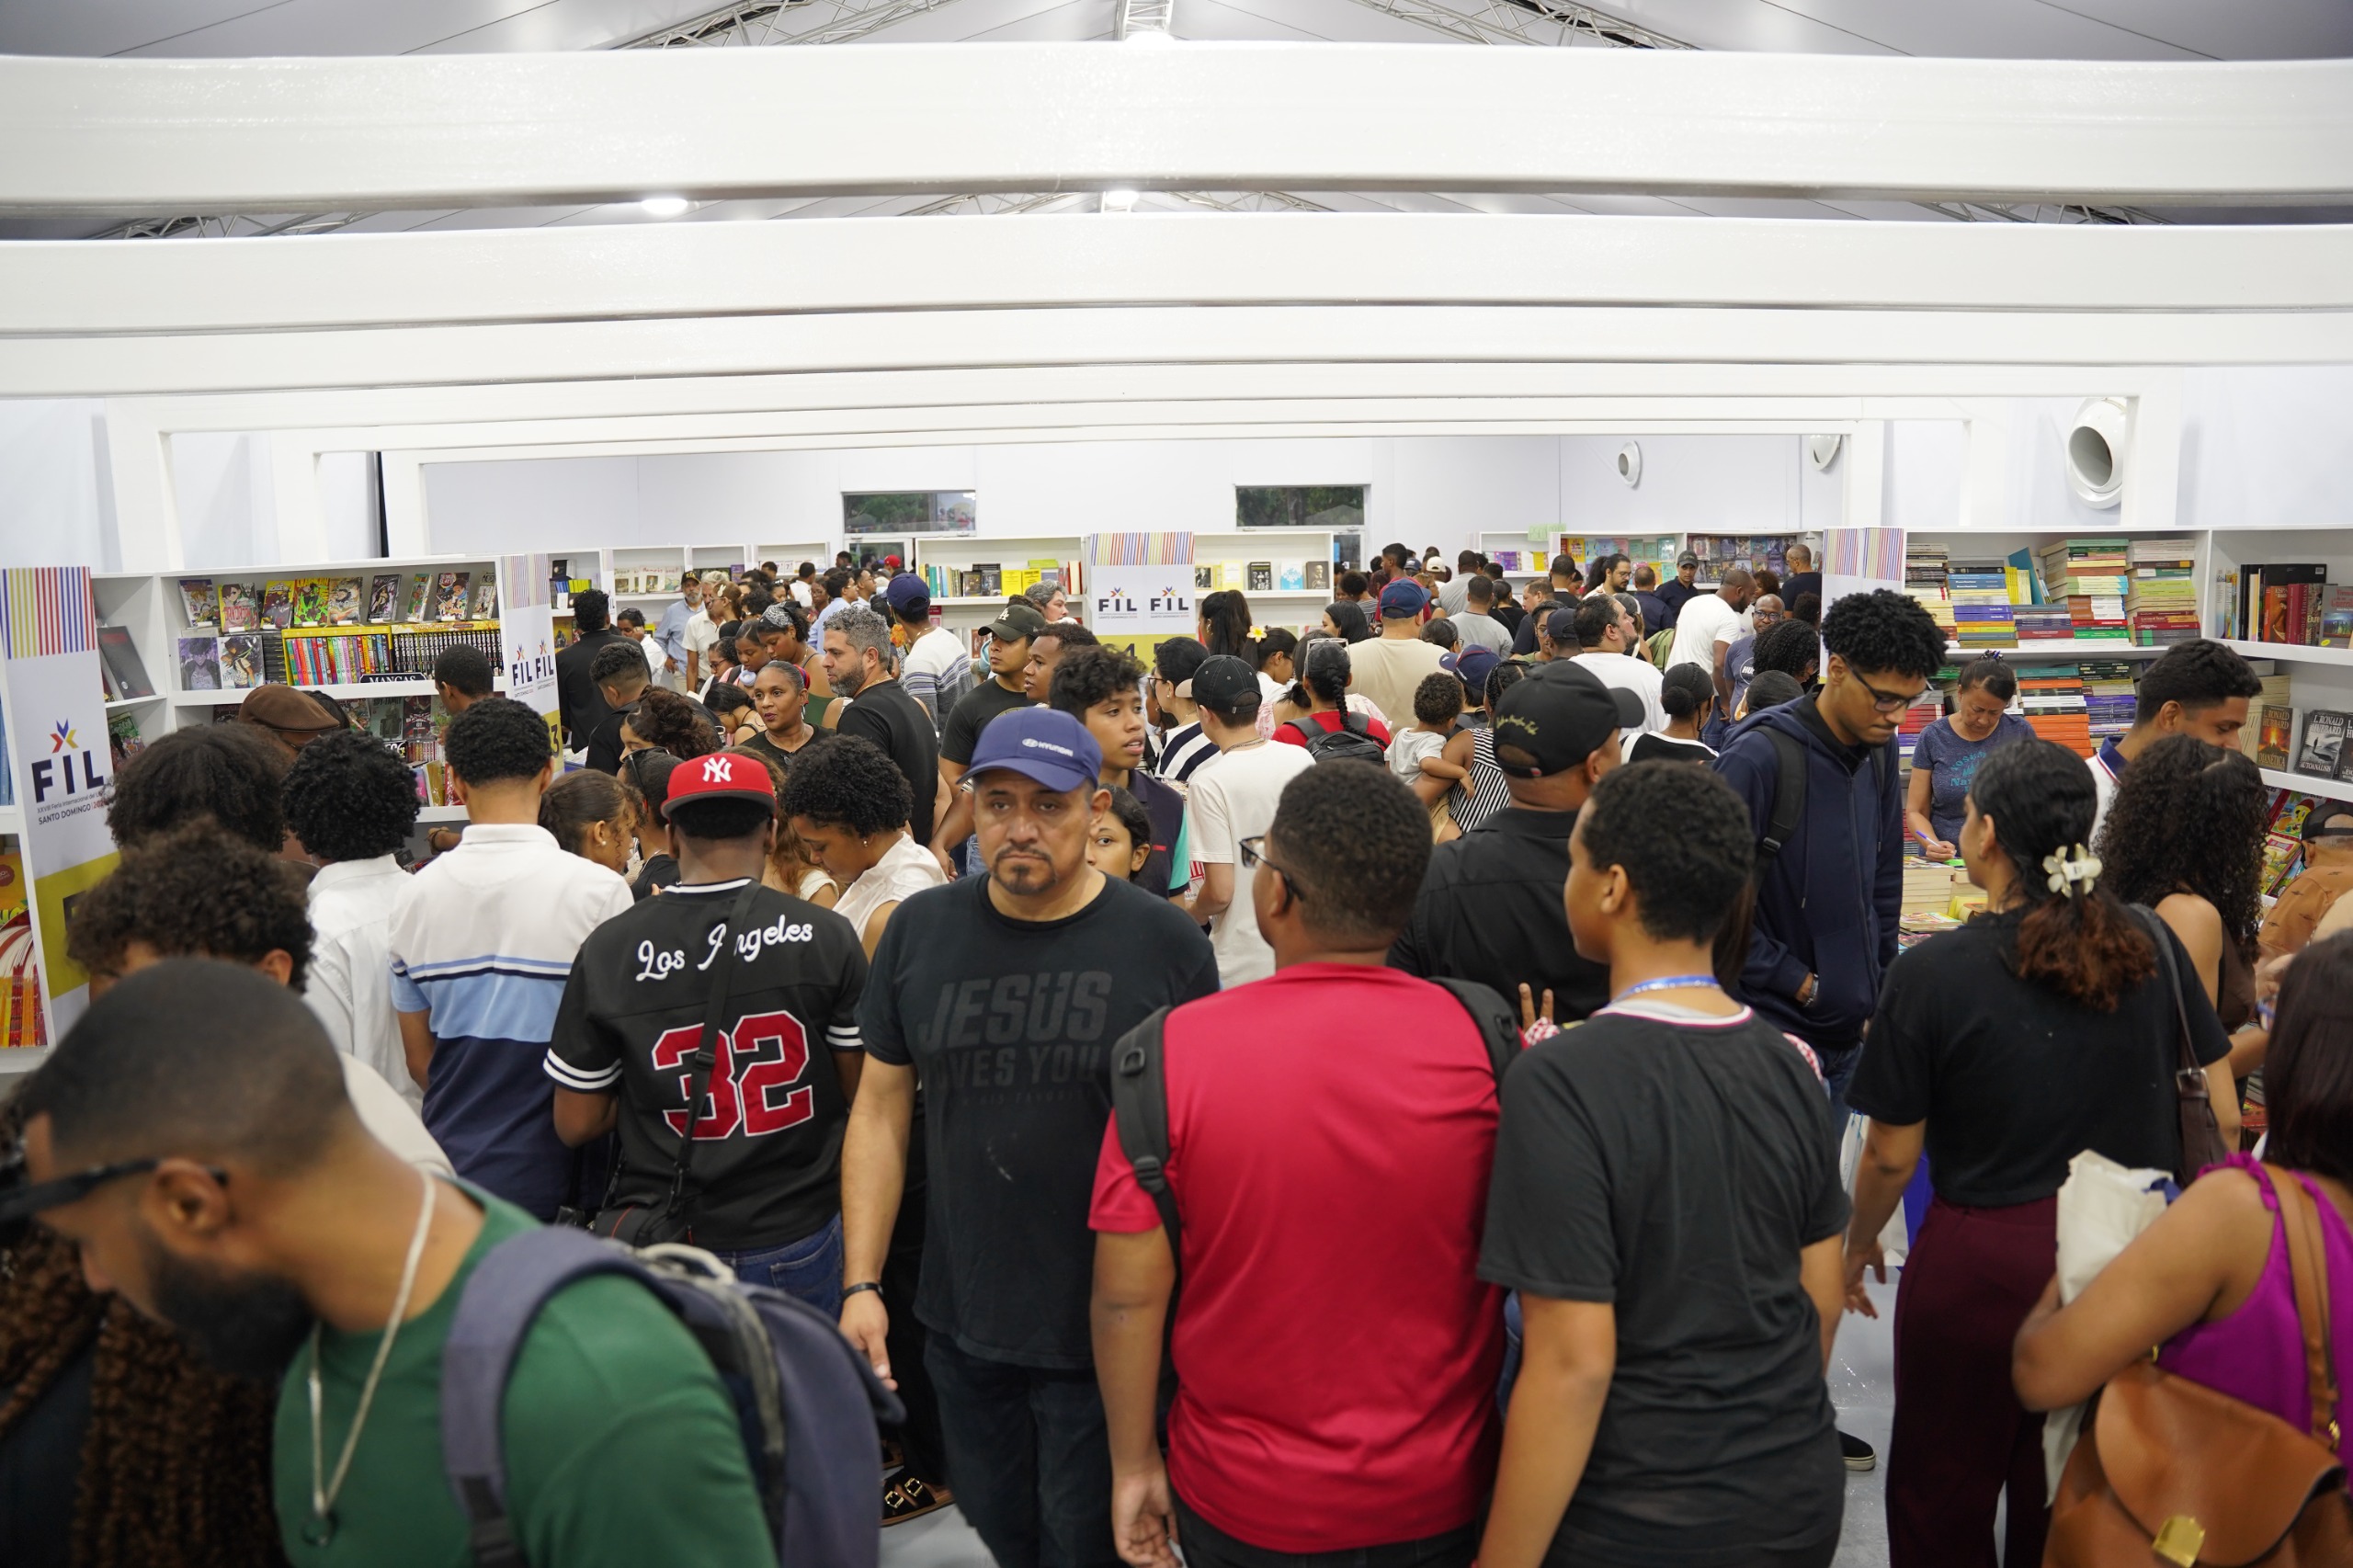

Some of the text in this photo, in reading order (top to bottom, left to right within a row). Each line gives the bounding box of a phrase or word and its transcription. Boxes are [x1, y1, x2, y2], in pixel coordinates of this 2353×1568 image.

[1098, 598, 1138, 612] FIL
[1150, 597, 1189, 611] FIL
[512, 661, 532, 687] FIL
[536, 655, 554, 679] FIL
[2318, 715, 2345, 726] RONALD
[1038, 741, 1074, 756] HYUNDAI
[31, 750, 105, 803] FIL
[38, 812, 61, 825] SANTO
[61, 803, 92, 819] DOMINGO
[635, 940, 686, 982] Los
[917, 971, 1113, 1055] JESUS
[652, 1010, 814, 1141] 32
[1028, 1043, 1101, 1085] YOU
